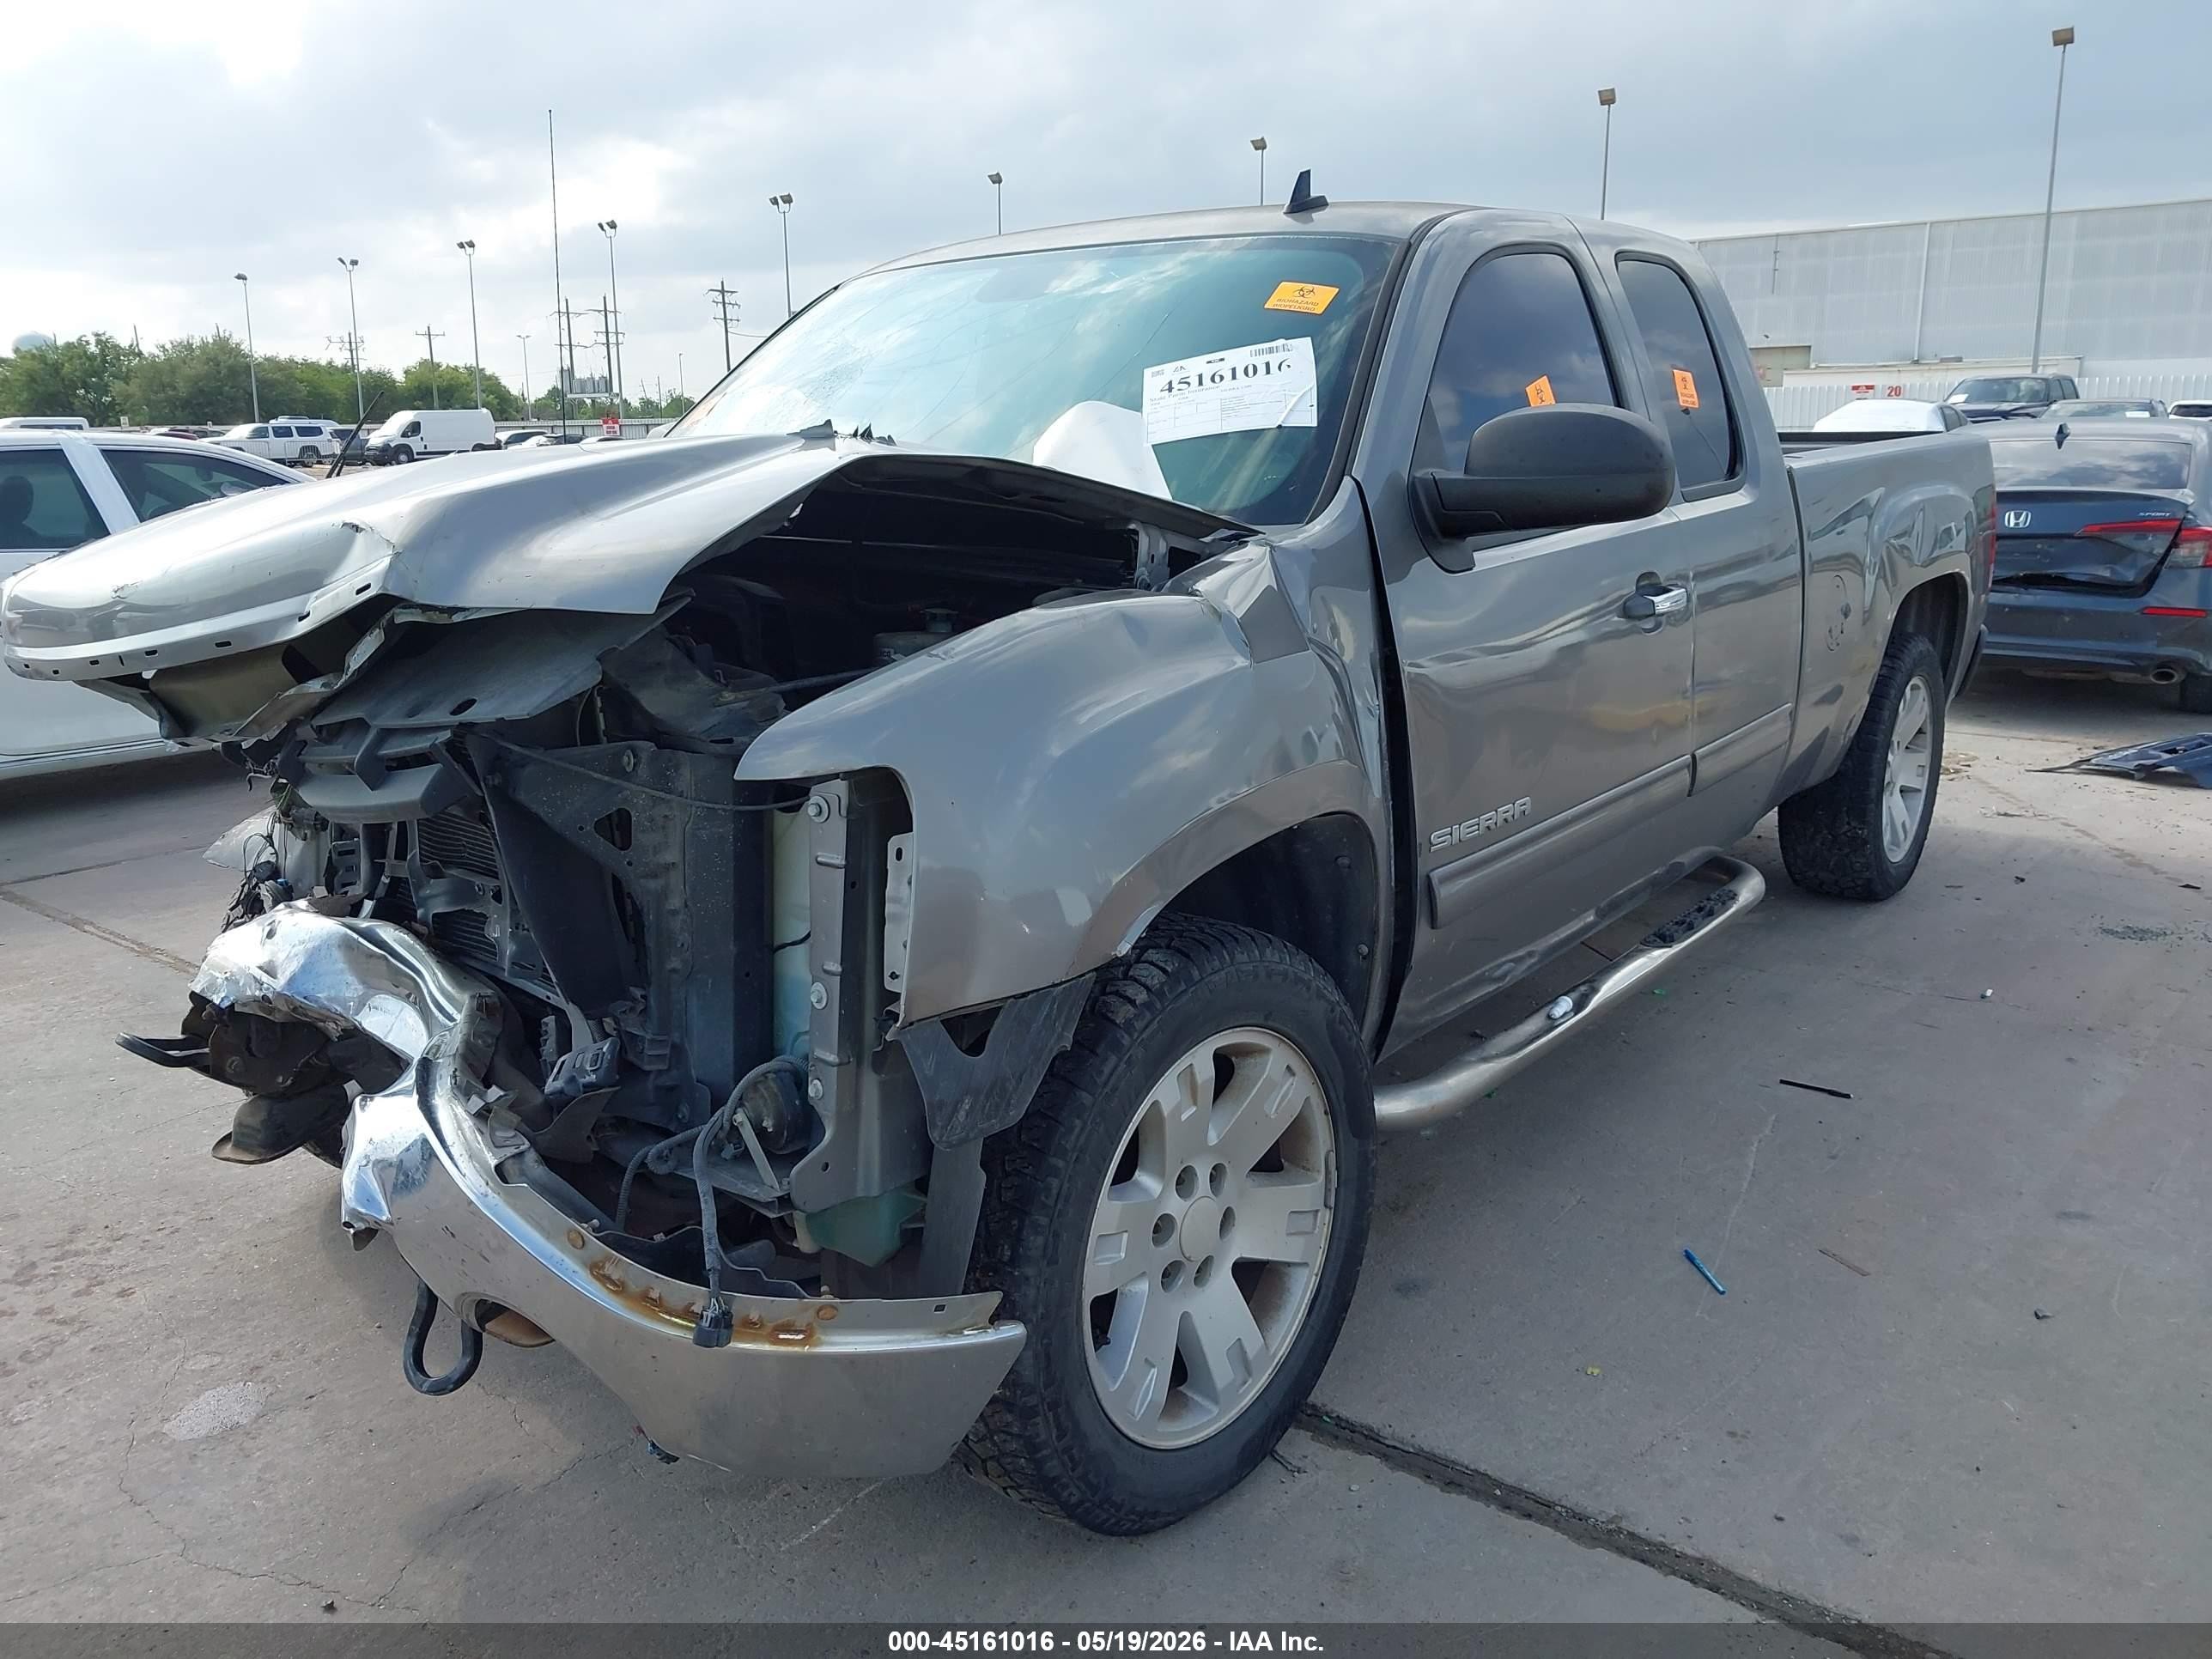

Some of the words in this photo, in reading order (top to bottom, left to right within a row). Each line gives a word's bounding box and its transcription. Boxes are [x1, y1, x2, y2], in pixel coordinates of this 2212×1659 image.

[1277, 297, 1319, 307] BIOHAZARD
[1159, 357, 1291, 393] 45161016
[1887, 385, 1902, 398] 20
[1430, 796, 1532, 853] SIERRA
